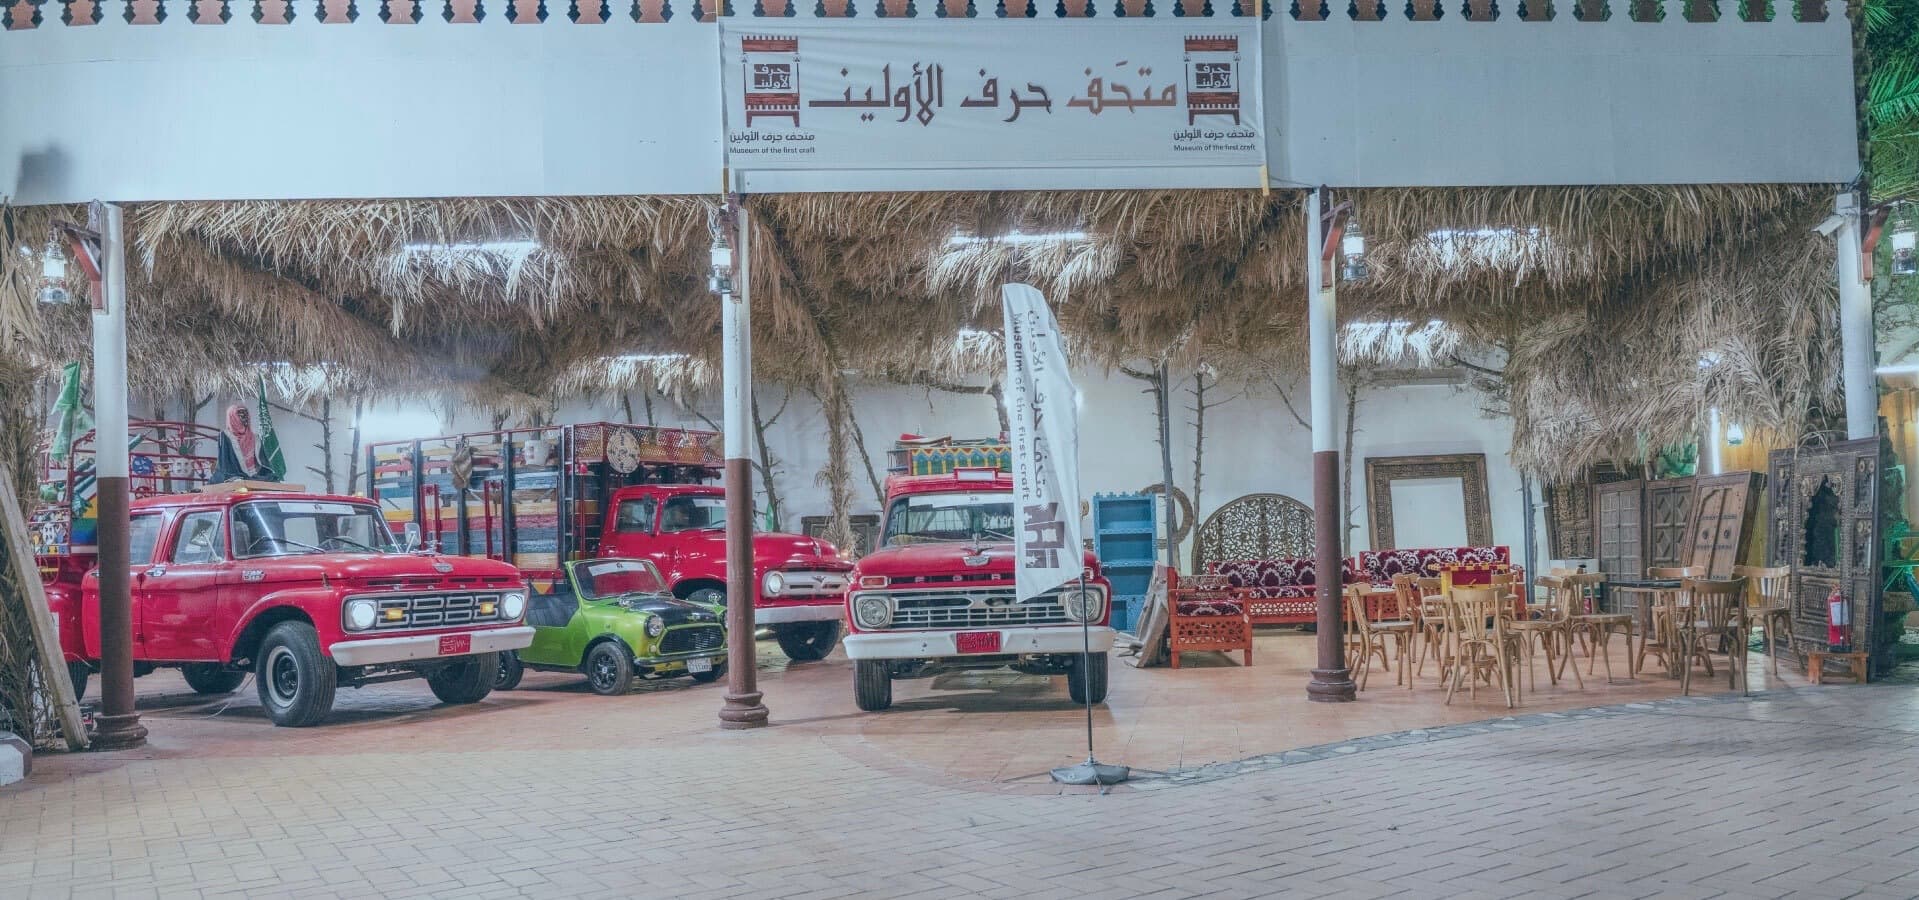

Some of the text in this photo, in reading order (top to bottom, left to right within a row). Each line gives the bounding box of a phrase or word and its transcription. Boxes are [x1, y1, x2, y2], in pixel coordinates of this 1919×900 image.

[960, 67, 1052, 123] حرف
[1226, 129, 1255, 139] متحف
[1013, 313, 1031, 501] Museum of the first craft
[1031, 378, 1047, 431] حرف
